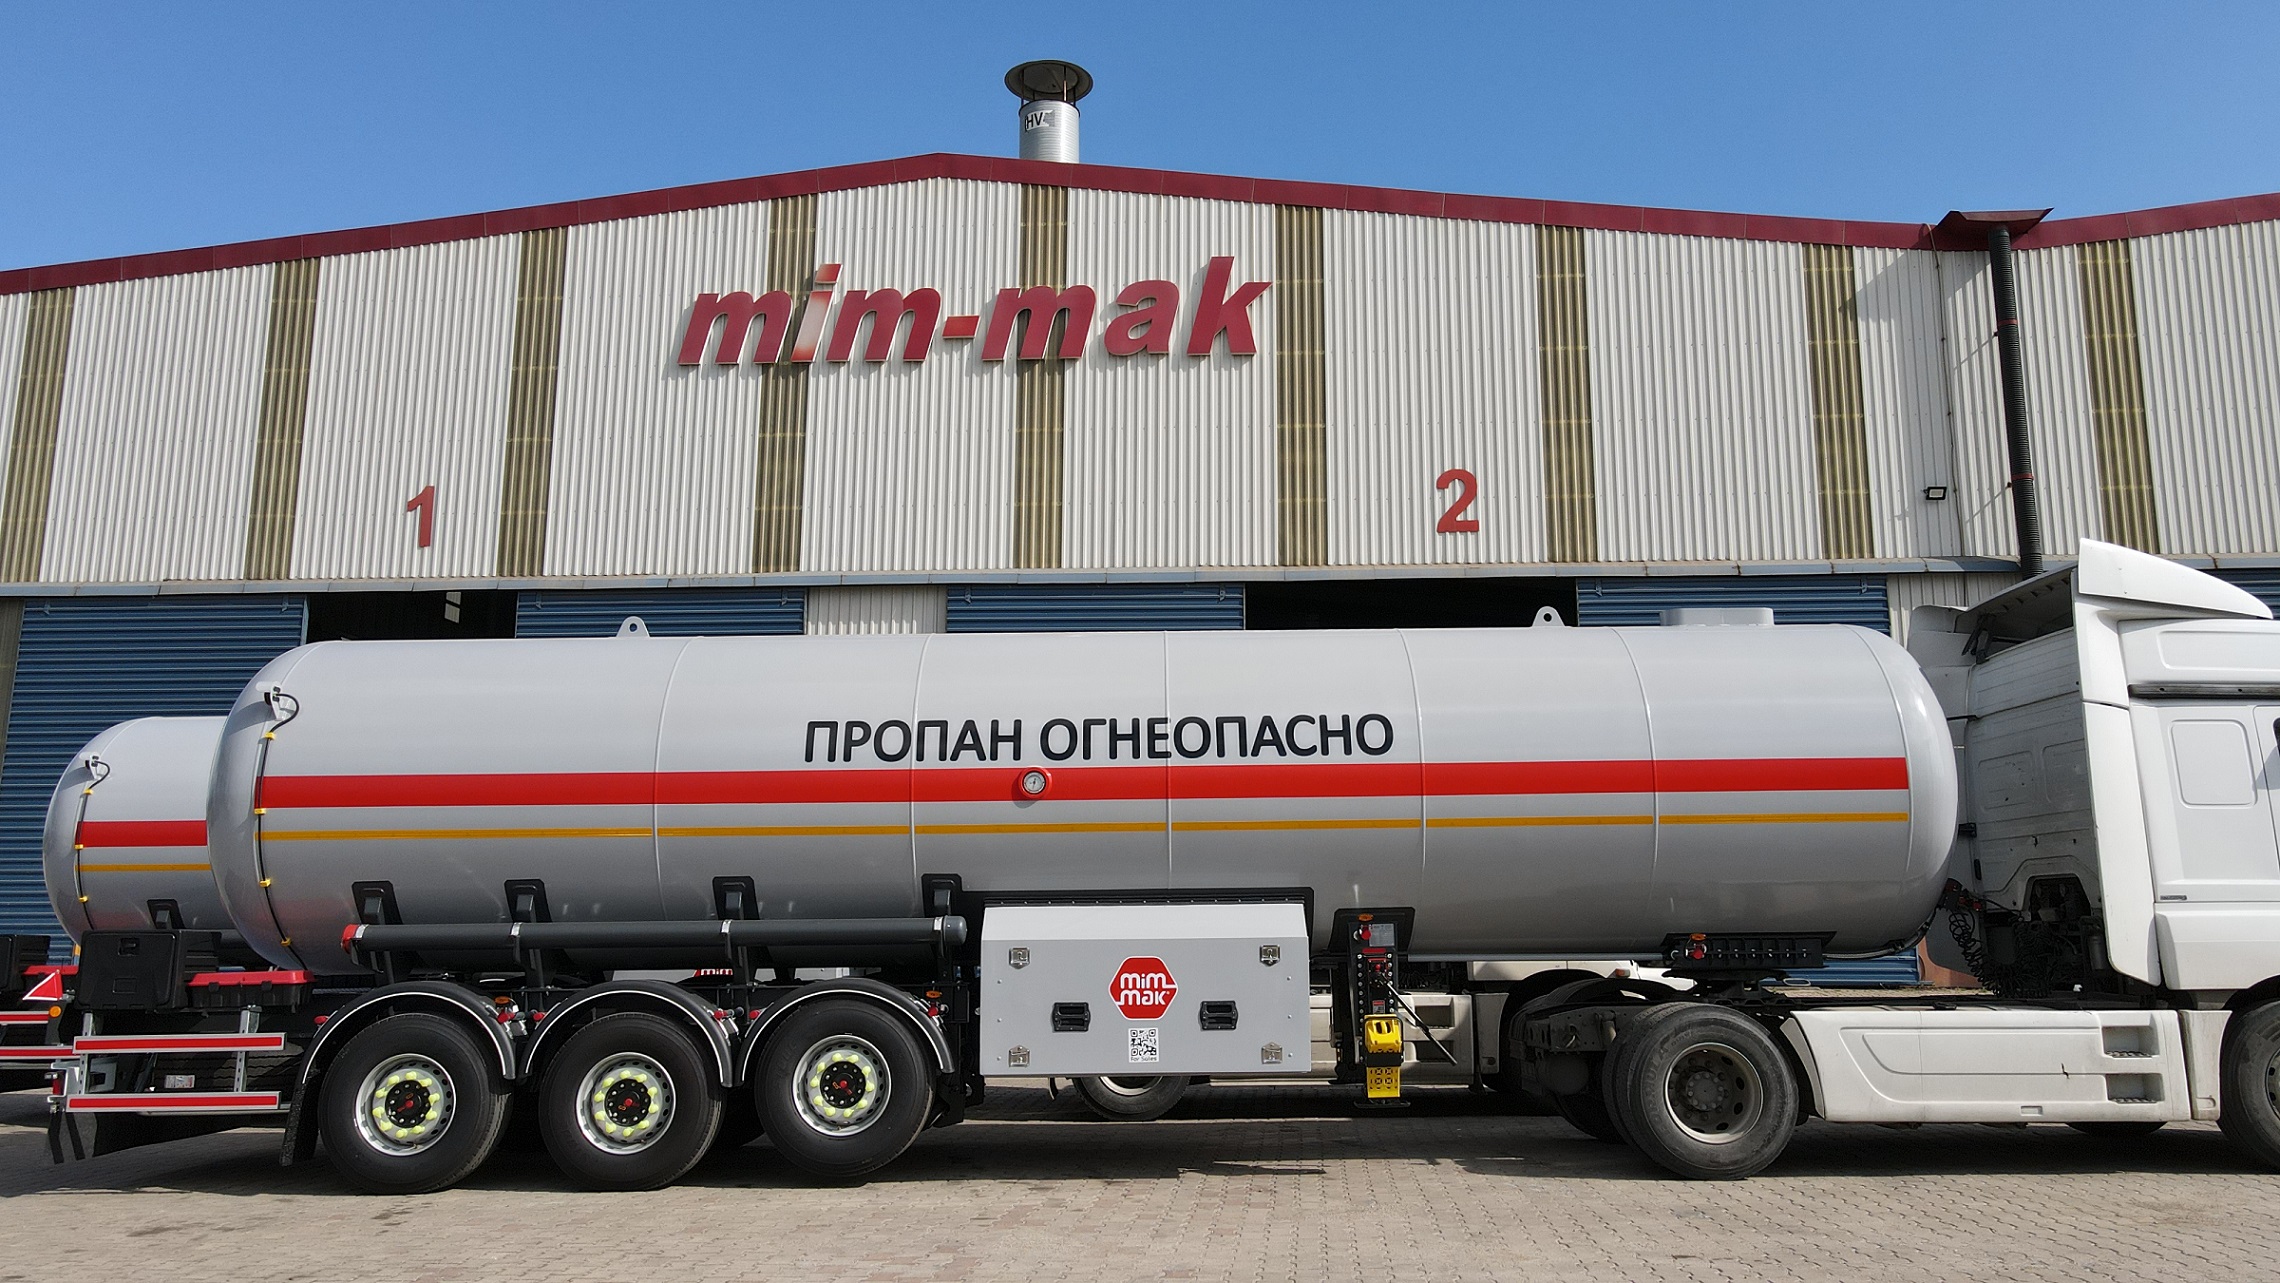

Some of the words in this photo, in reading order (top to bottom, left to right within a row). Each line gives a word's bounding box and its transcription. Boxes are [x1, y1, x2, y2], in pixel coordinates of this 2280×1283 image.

[677, 255, 1273, 366] mim-mak
[406, 485, 436, 549] 1
[1436, 468, 1480, 534] 2
[805, 720, 1021, 762] ПРОПАН
[1039, 714, 1394, 760] ОГНЕОПАСНО
[1120, 972, 1167, 989] mim
[1120, 989, 1167, 1005] mak
